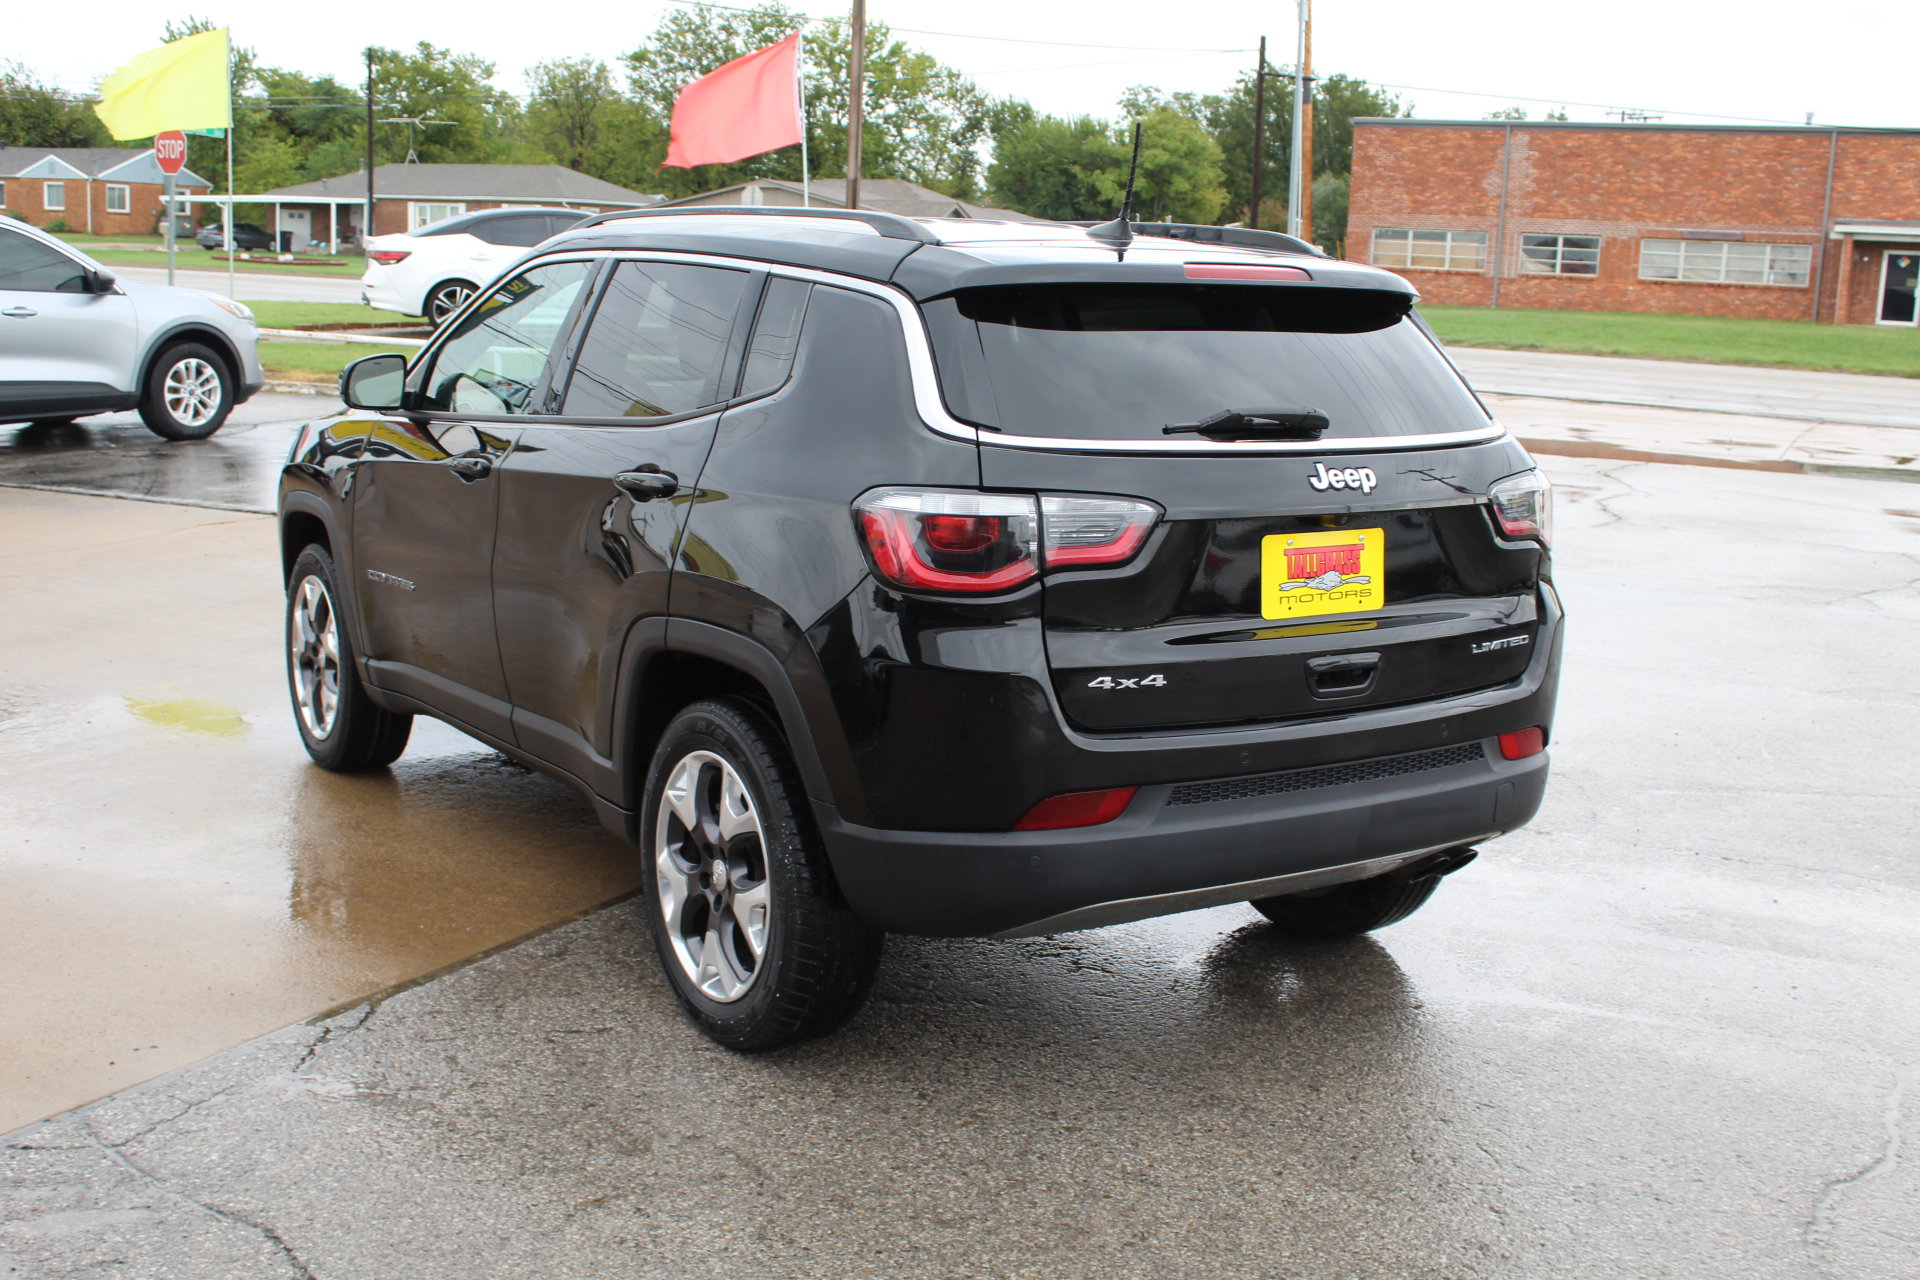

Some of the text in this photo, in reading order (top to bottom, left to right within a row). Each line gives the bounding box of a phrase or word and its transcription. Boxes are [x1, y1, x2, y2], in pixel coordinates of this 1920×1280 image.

[157, 139, 184, 159] STOP
[1308, 462, 1377, 495] Jeep
[1283, 543, 1365, 580] TALLGRASS
[1279, 588, 1373, 605] MOTORS
[1472, 635, 1530, 654] LIMITED
[1087, 674, 1167, 690] 4x4
